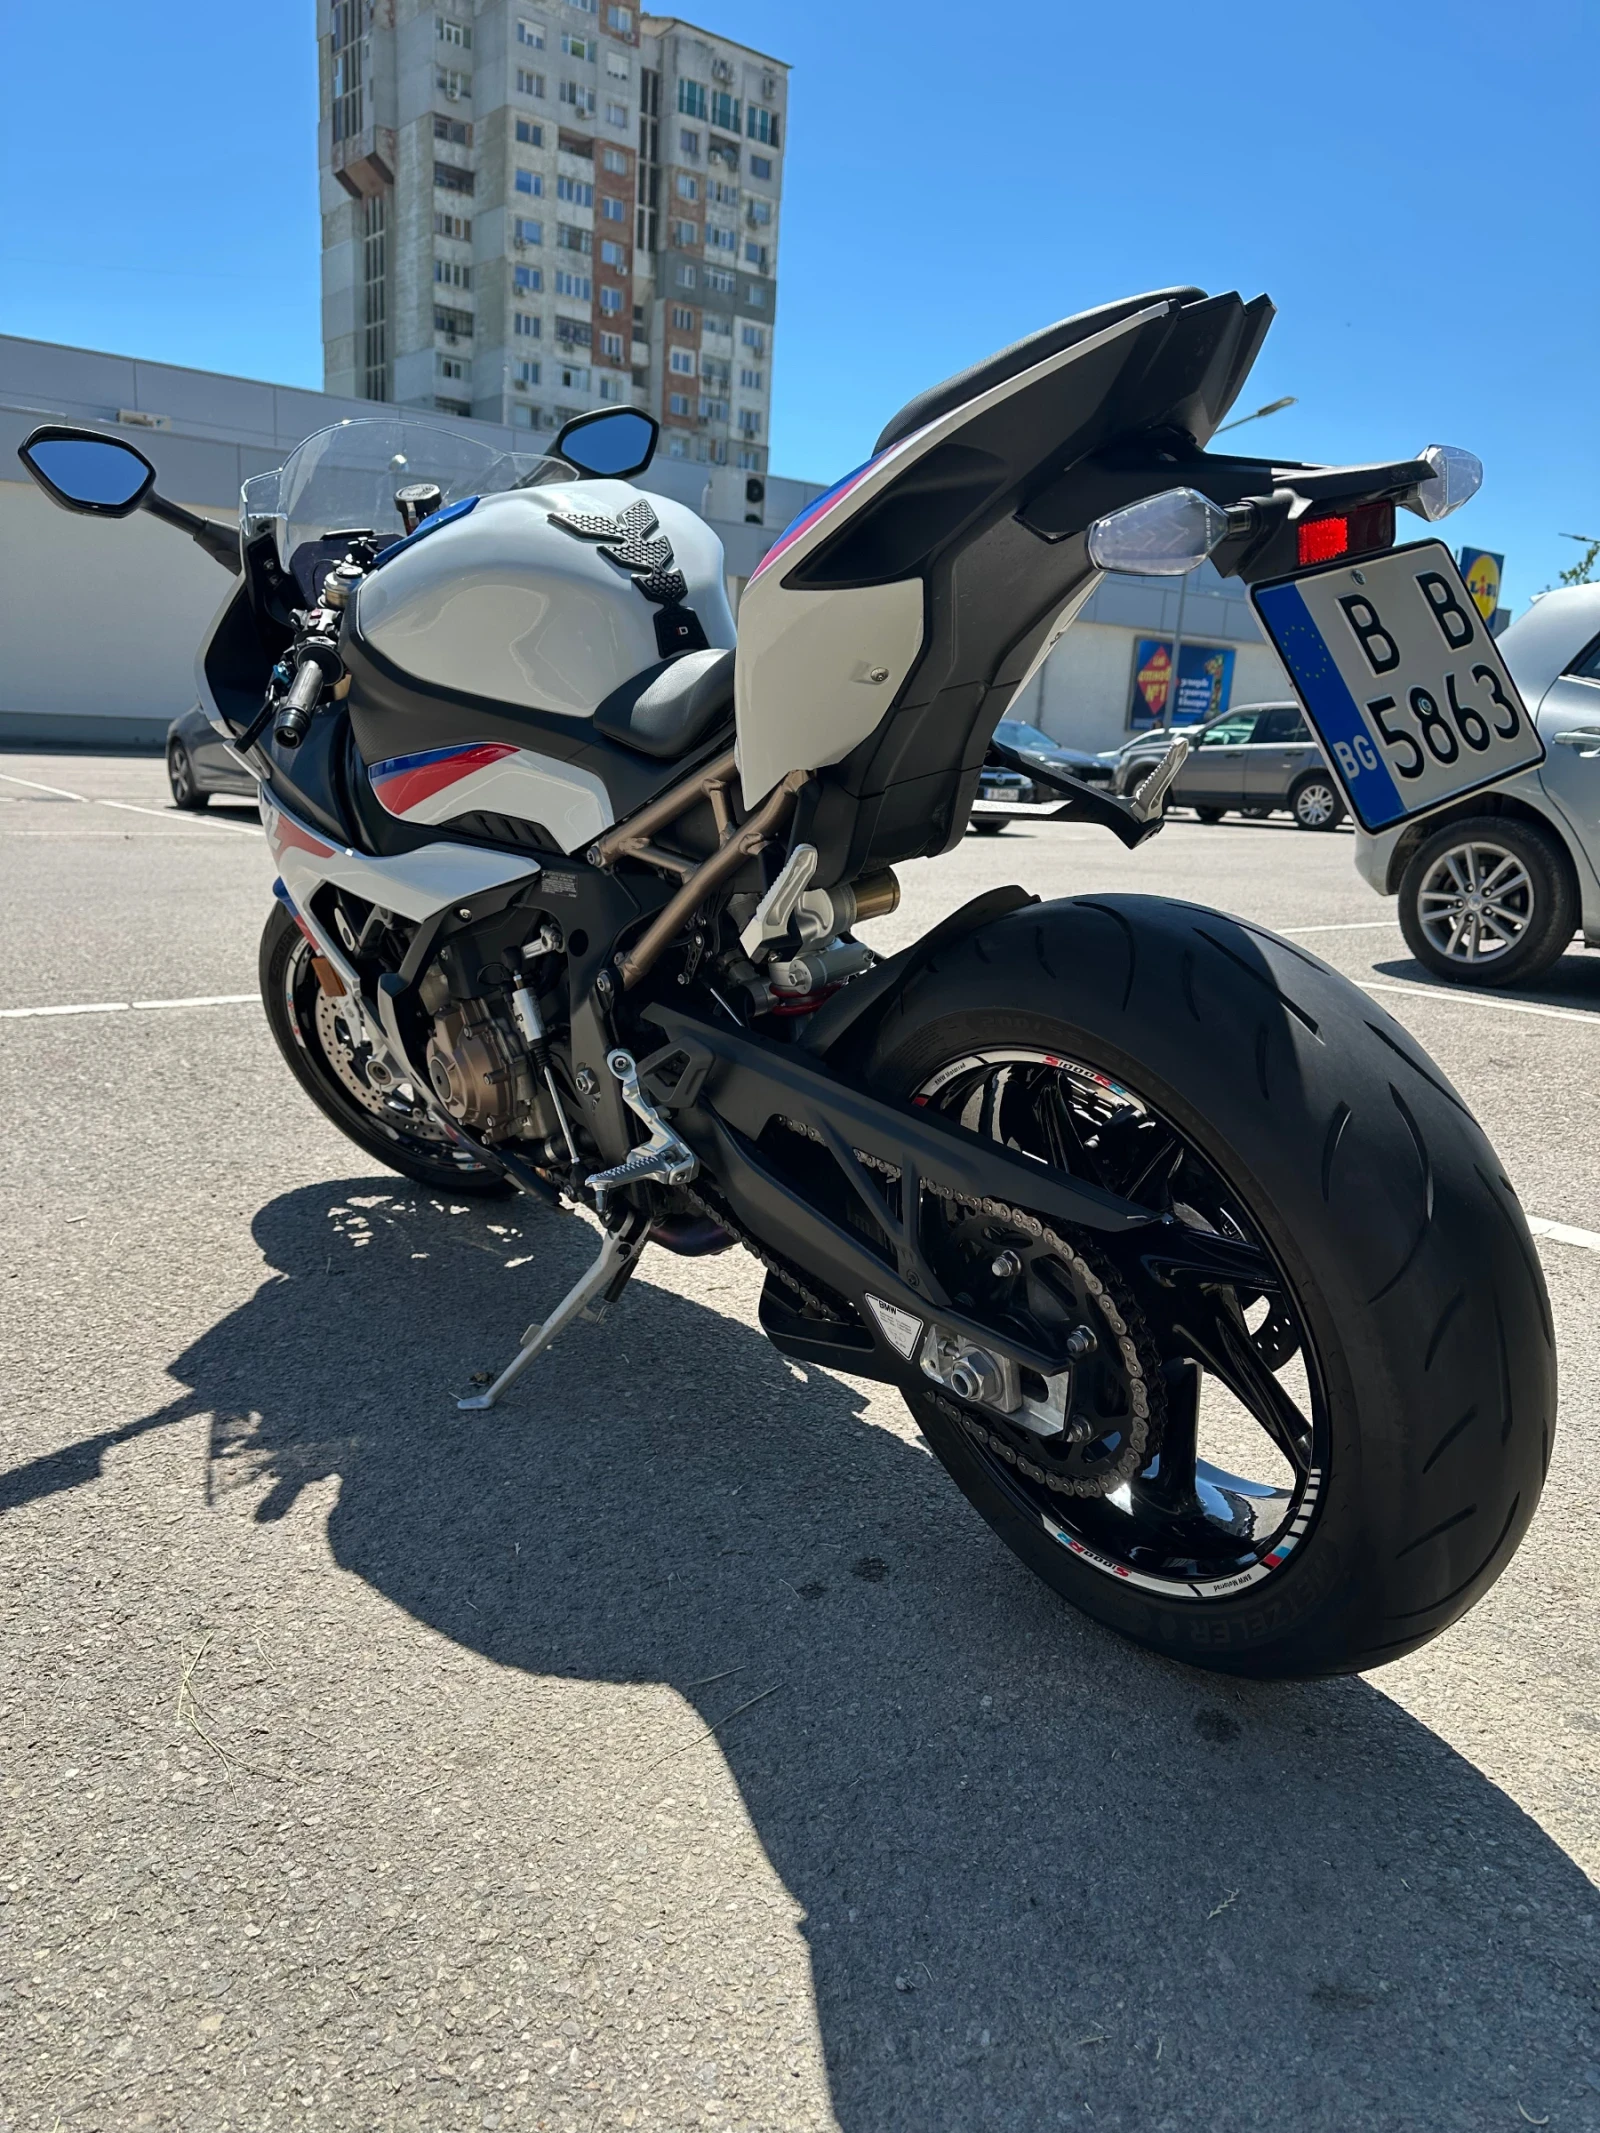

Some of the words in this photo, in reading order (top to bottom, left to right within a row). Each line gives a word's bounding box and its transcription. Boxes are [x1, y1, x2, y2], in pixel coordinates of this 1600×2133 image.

[1336, 594, 1400, 675] B
[1415, 571, 1474, 650] B
[1366, 664, 1520, 778] 5863
[1332, 737, 1378, 779] BG
[271, 926, 298, 981] SPORT
[878, 1300, 897, 1315] BMW
